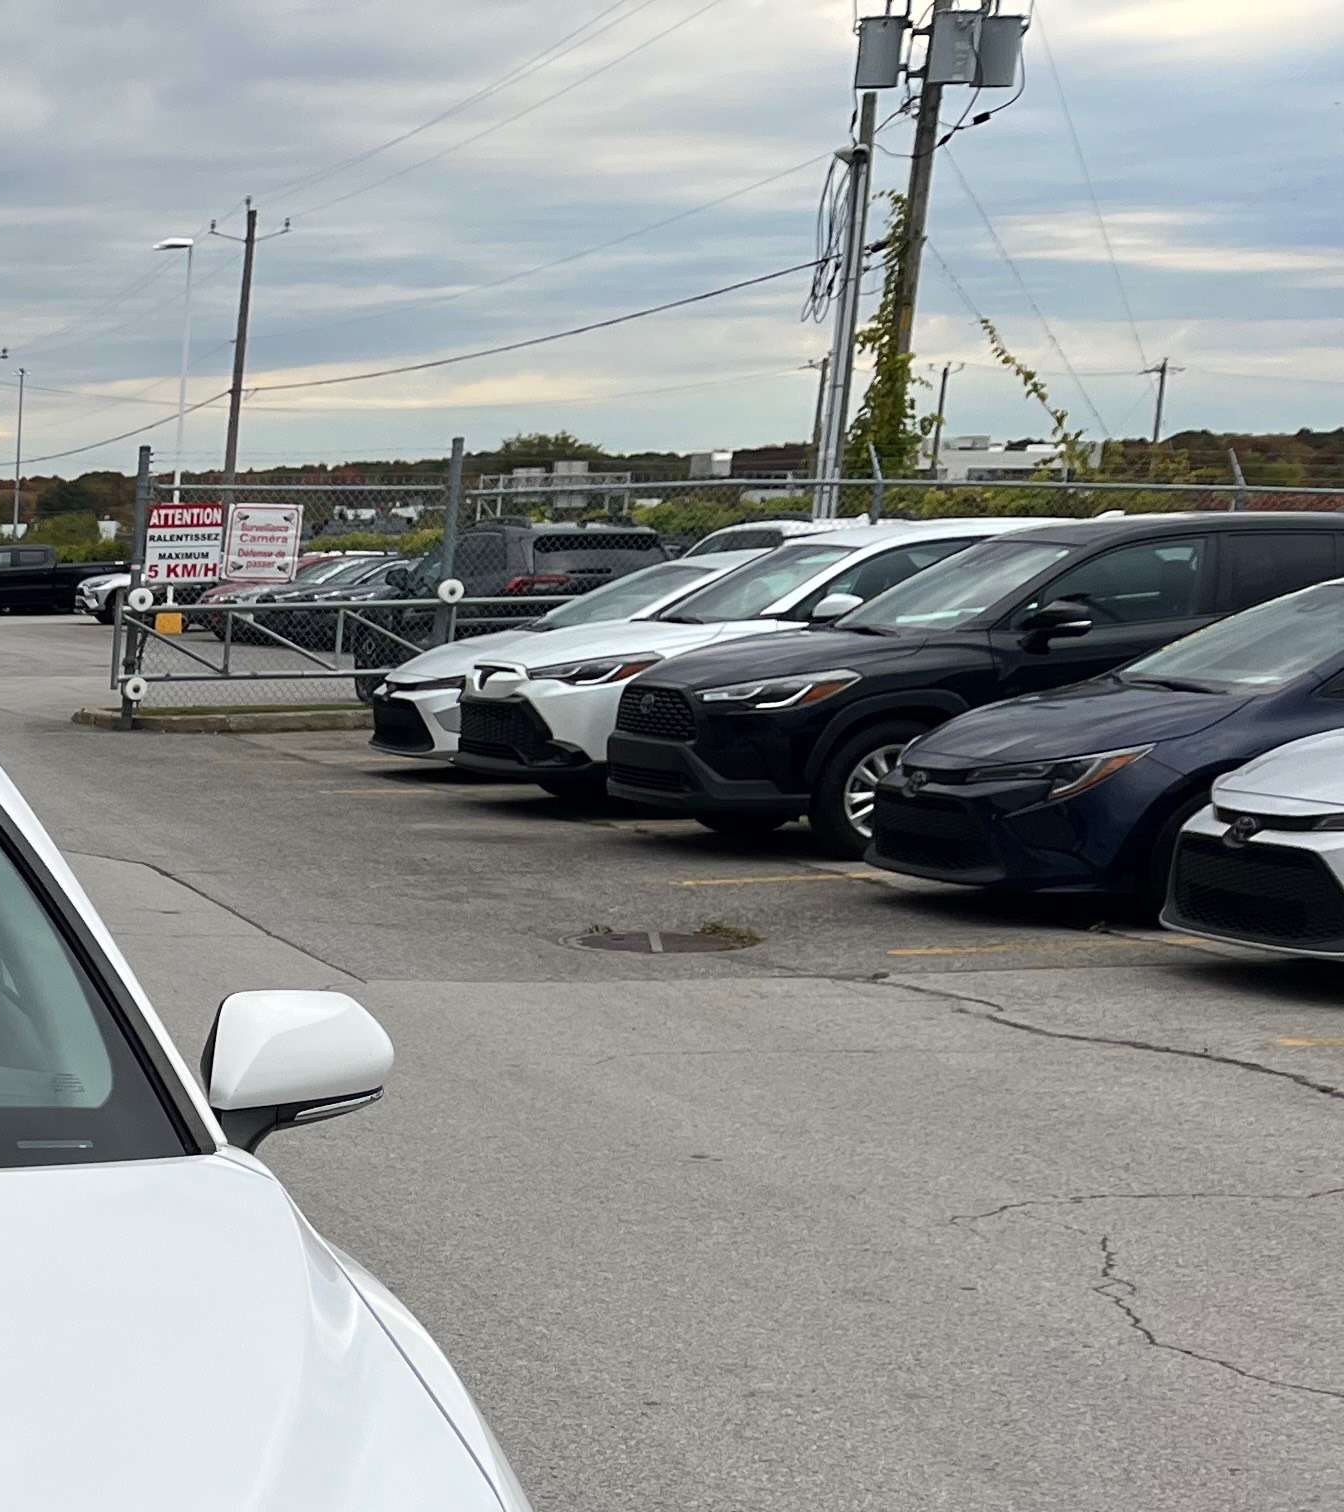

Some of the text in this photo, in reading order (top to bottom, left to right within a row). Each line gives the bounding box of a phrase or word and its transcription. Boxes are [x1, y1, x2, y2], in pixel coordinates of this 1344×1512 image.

[149, 507, 223, 526] ATTENTION
[148, 533, 220, 542] RALENTISSEZ
[158, 551, 209, 560] MAXIMUM
[148, 563, 218, 578] 5 KM/H
